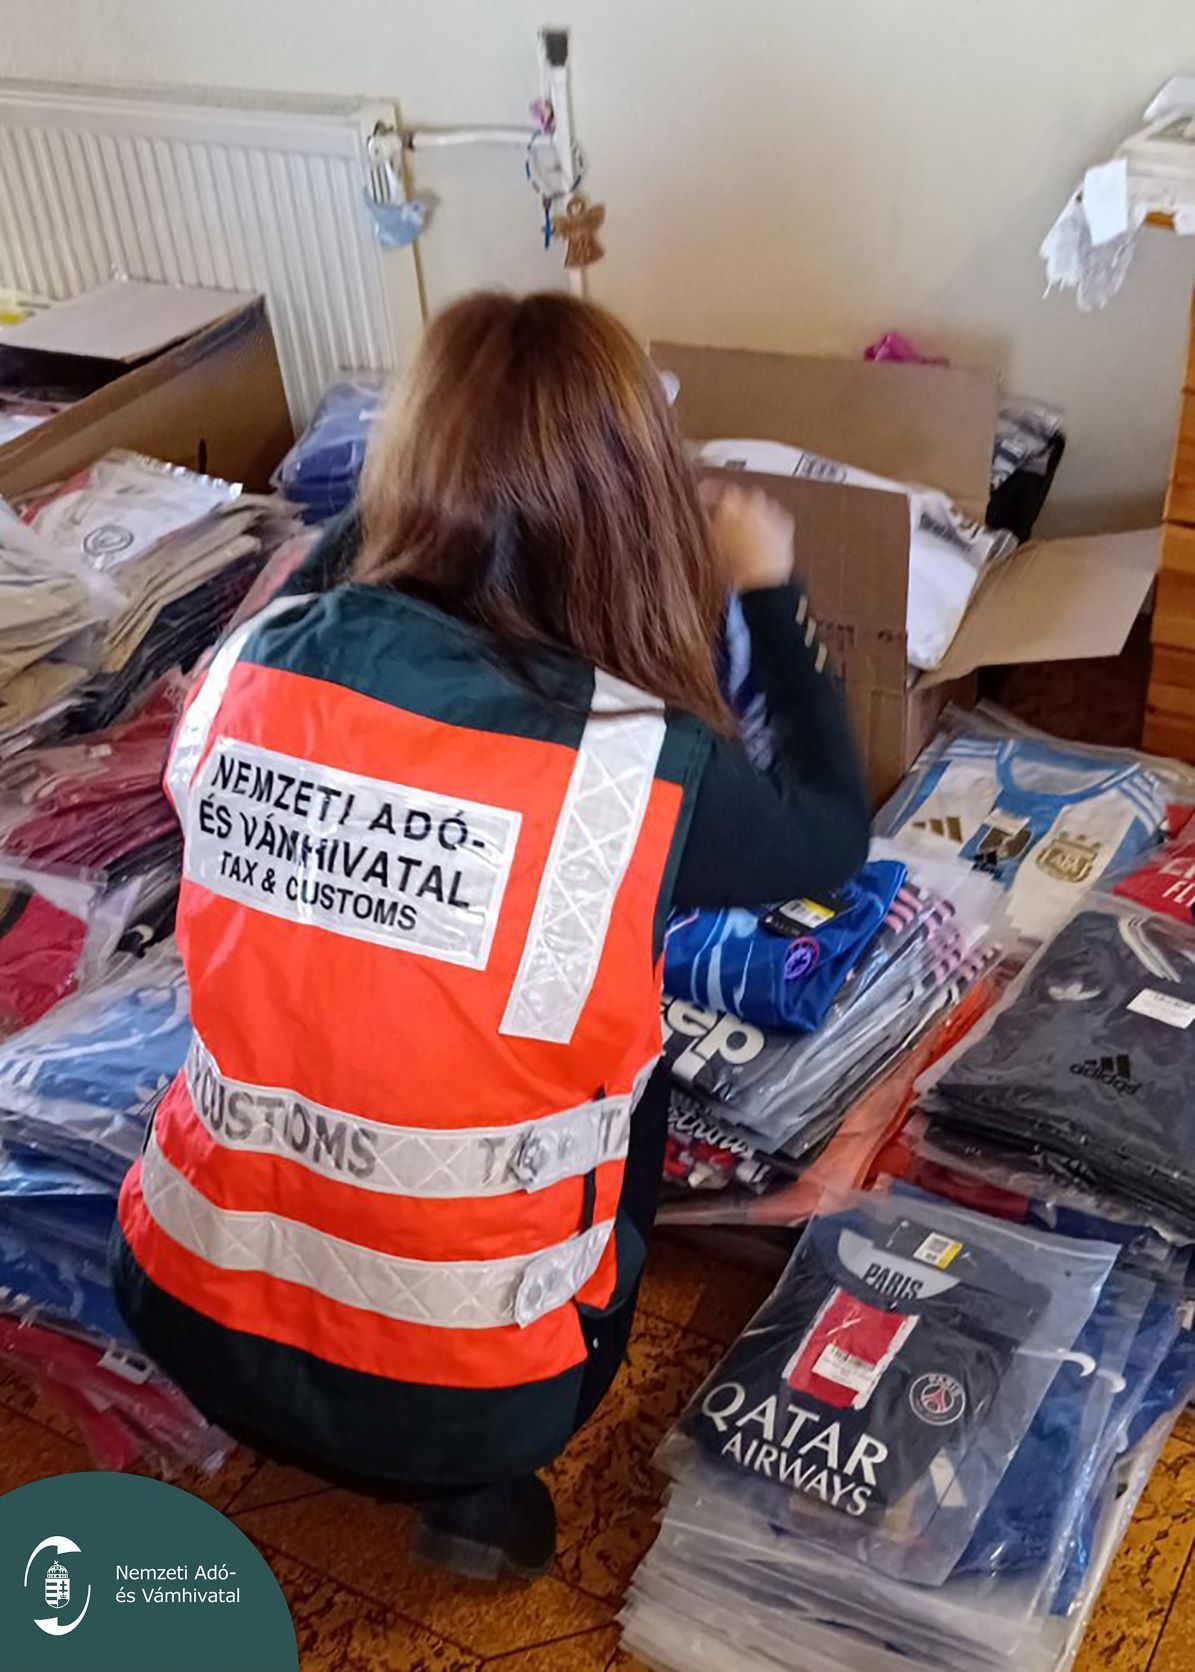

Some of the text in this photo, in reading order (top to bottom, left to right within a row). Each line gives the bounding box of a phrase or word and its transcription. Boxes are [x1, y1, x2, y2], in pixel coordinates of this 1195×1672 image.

[200, 793, 232, 839] ÉS
[211, 753, 487, 852] NEMZETI ADÓ-
[220, 850, 418, 932] TAX & CUSTOMS
[199, 1065, 378, 1179] CUSTOMS
[863, 1262, 925, 1299] PARIS
[701, 1380, 889, 1486] QATAR
[721, 1434, 873, 1518] AIRWAYS
